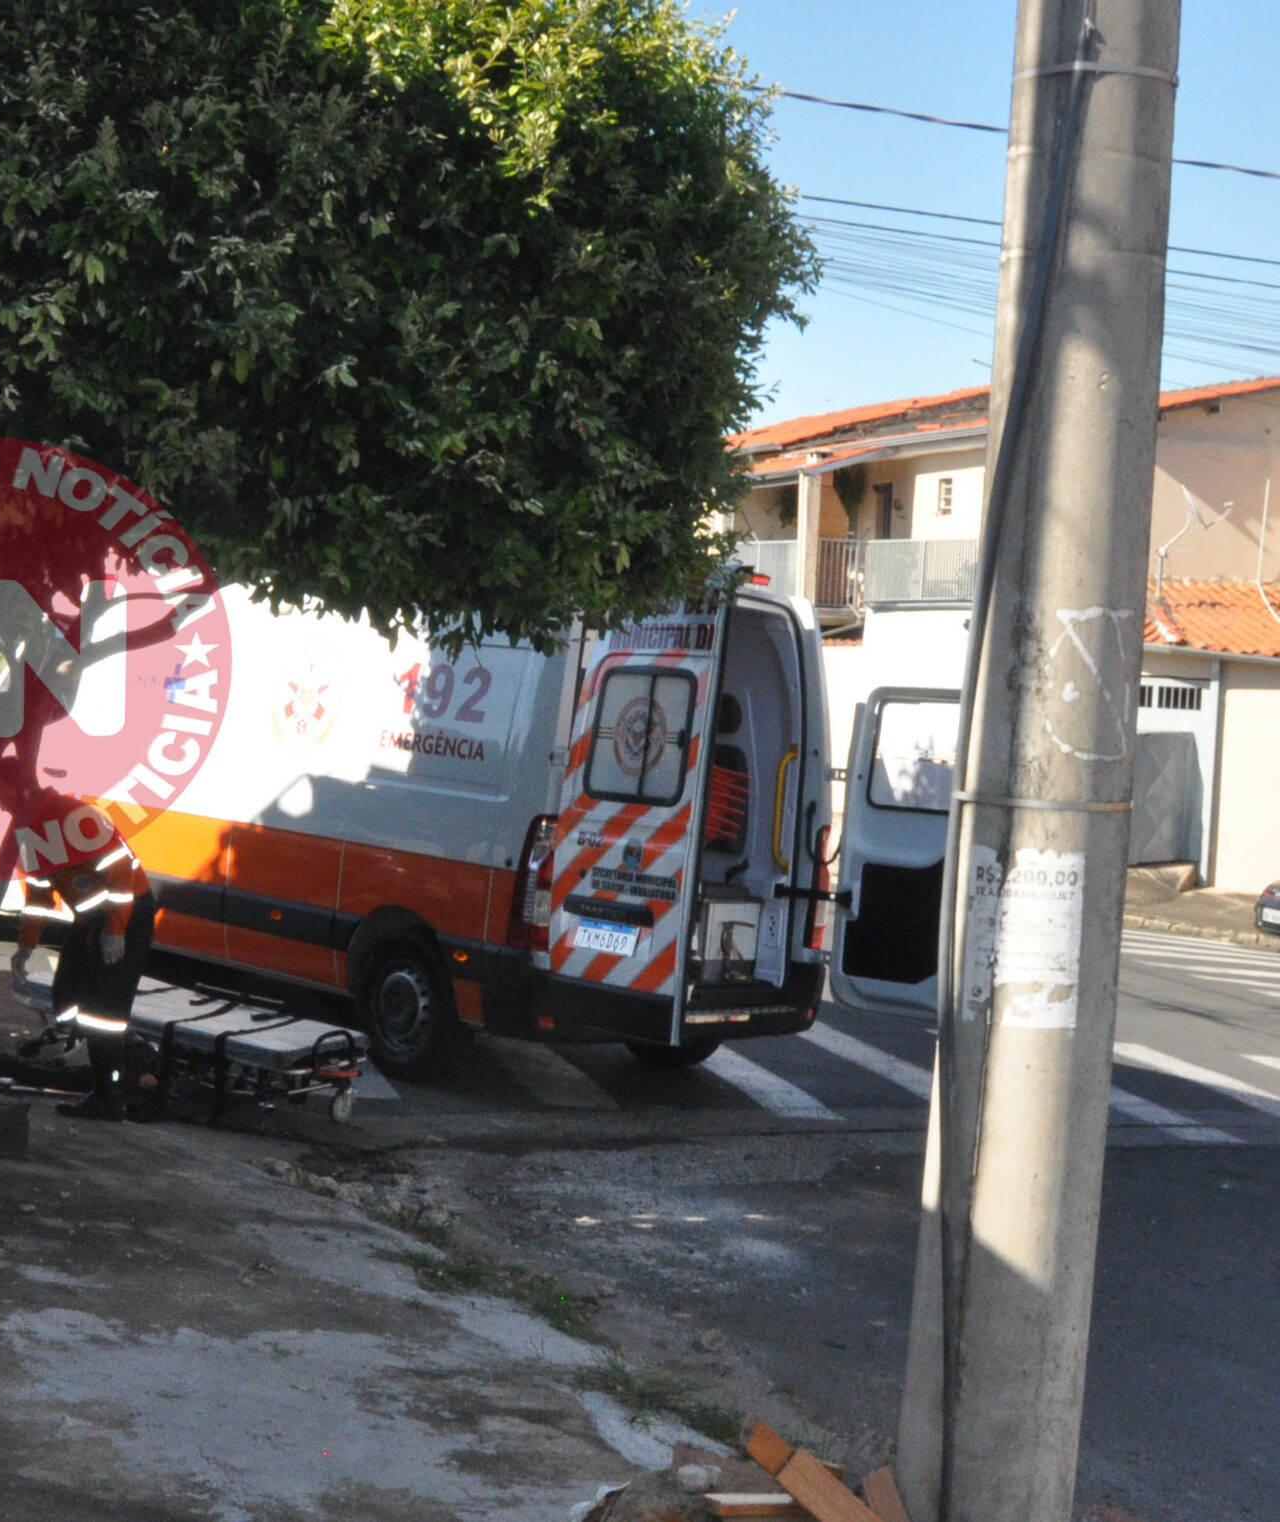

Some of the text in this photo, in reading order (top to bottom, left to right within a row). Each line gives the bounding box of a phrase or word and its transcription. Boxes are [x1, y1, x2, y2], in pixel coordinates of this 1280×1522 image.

[609, 622, 690, 649] MUNICIPAL
[392, 662, 492, 723] 192
[379, 729, 485, 761] EMERGÊNCIA
